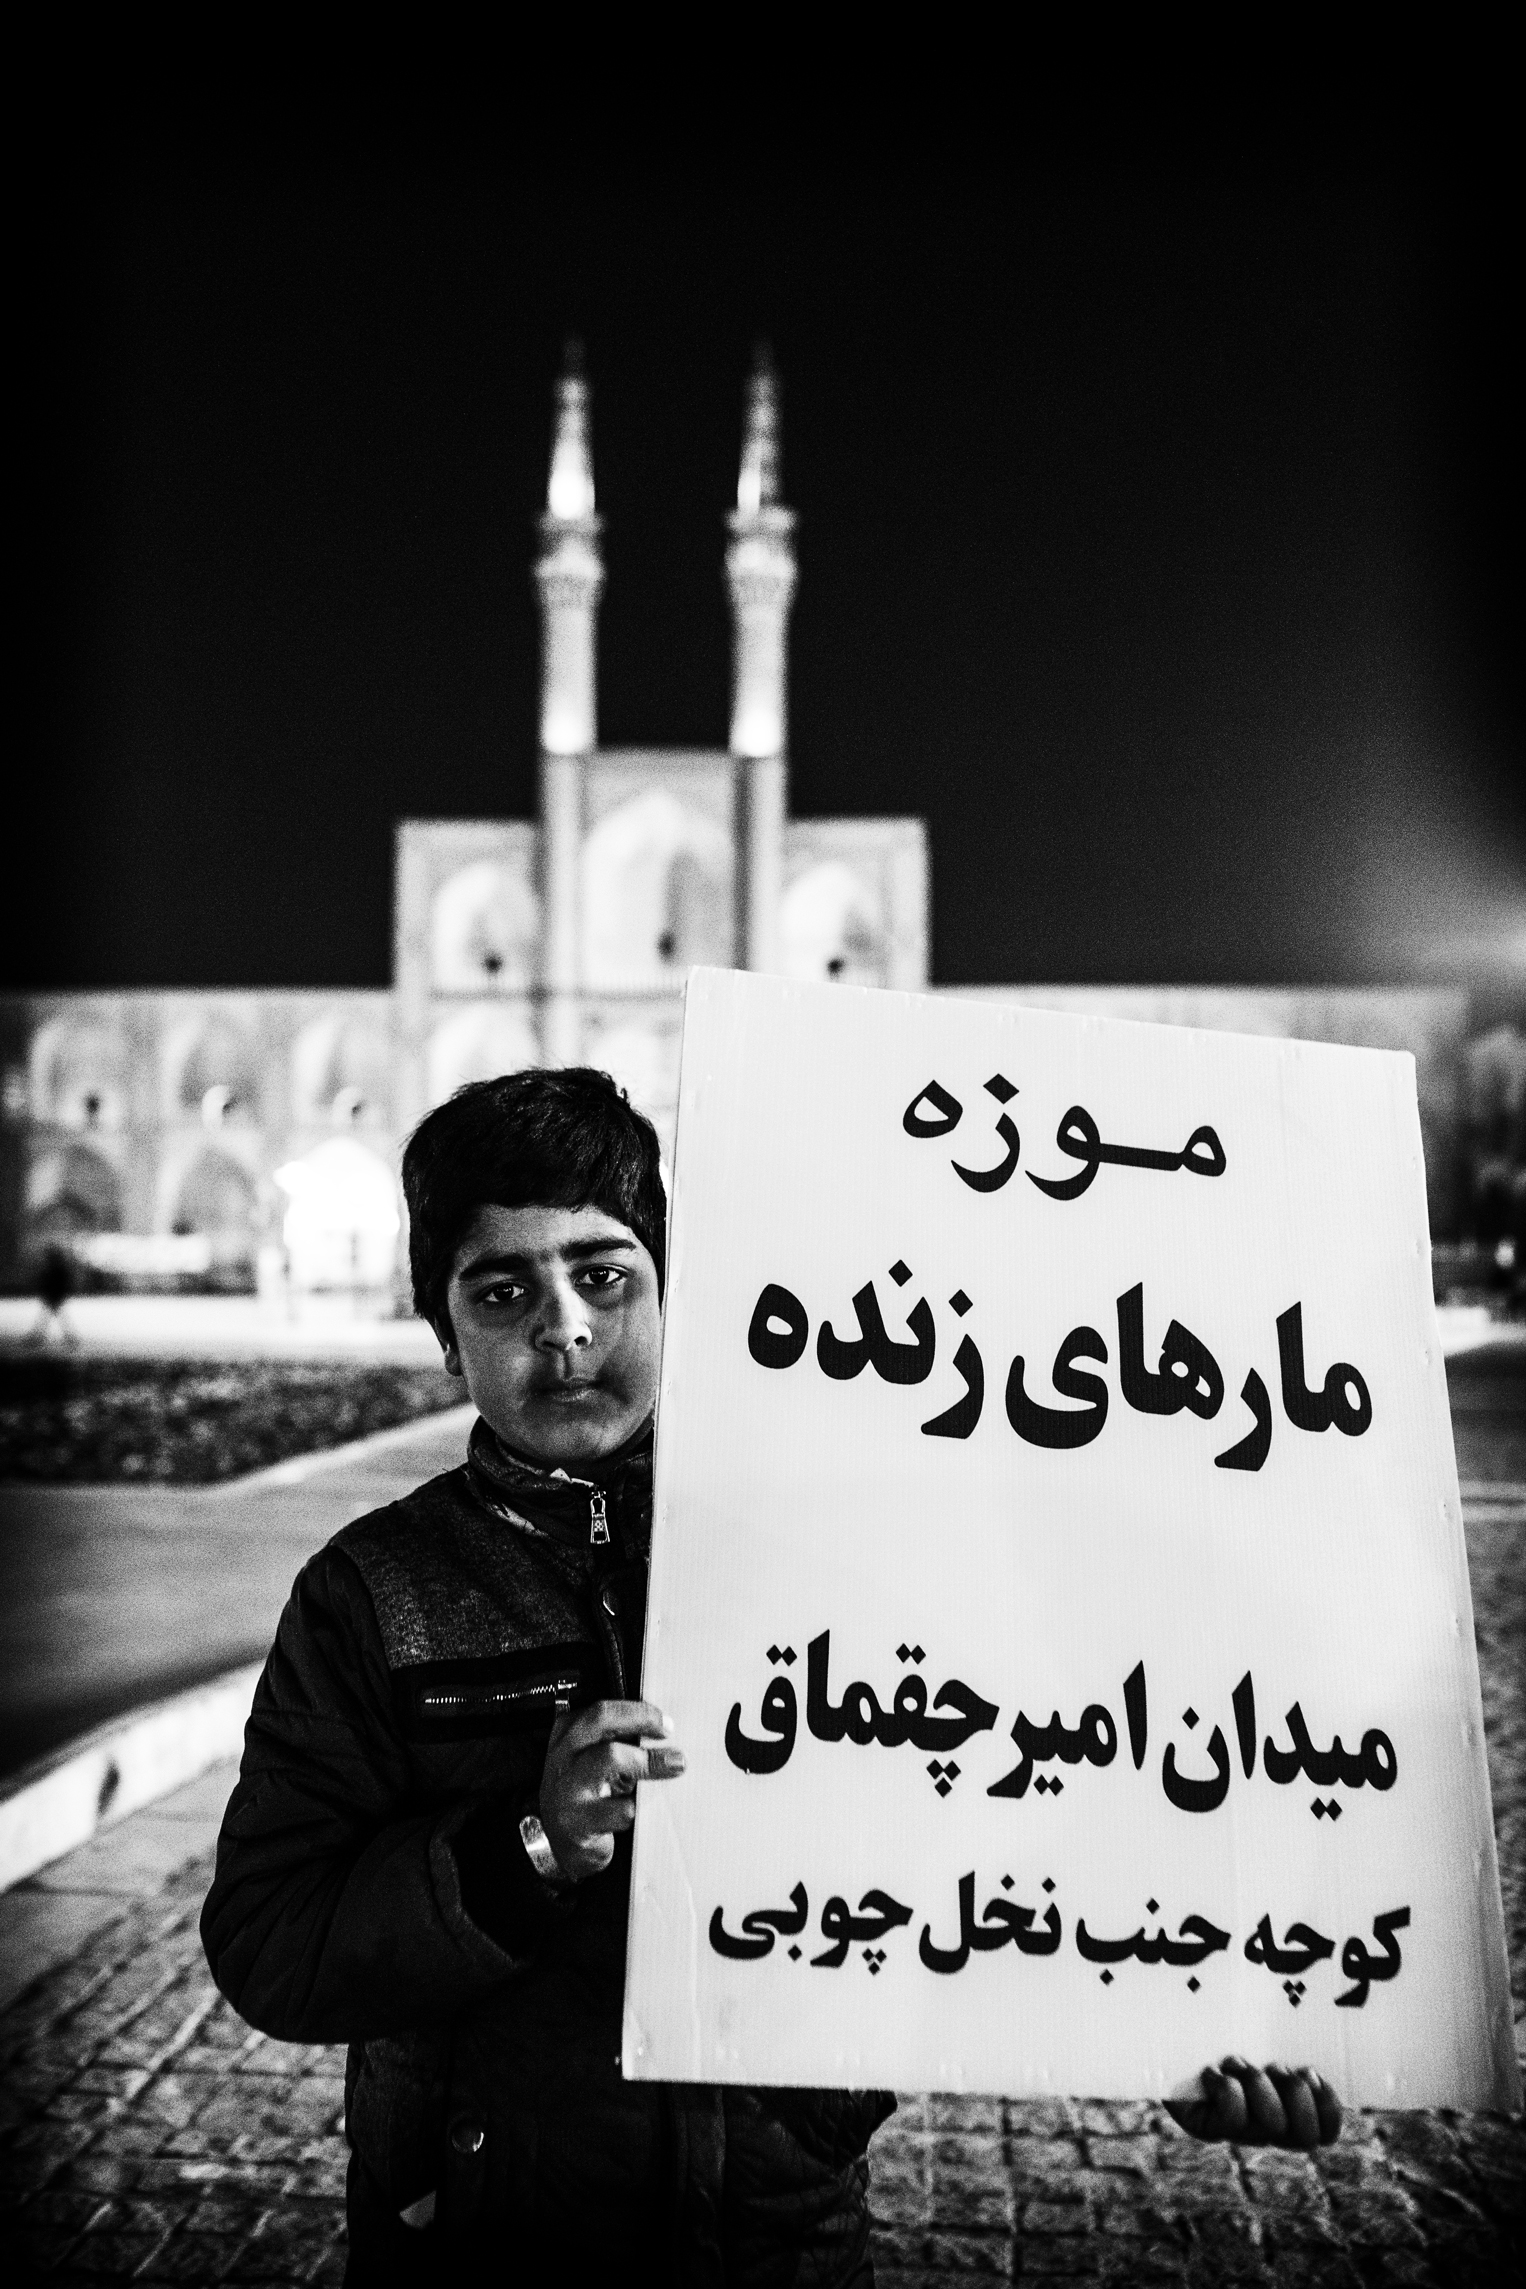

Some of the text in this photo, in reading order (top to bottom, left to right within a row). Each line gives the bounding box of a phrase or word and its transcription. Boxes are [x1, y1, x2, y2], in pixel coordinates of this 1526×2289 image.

[902, 1073, 1227, 1201] موزه
[747, 1259, 1373, 1472] مارهای زنده
[1161, 1670, 1398, 1822] میدان
[708, 1870, 1411, 2009] کوچه جنب نخل چوبی
